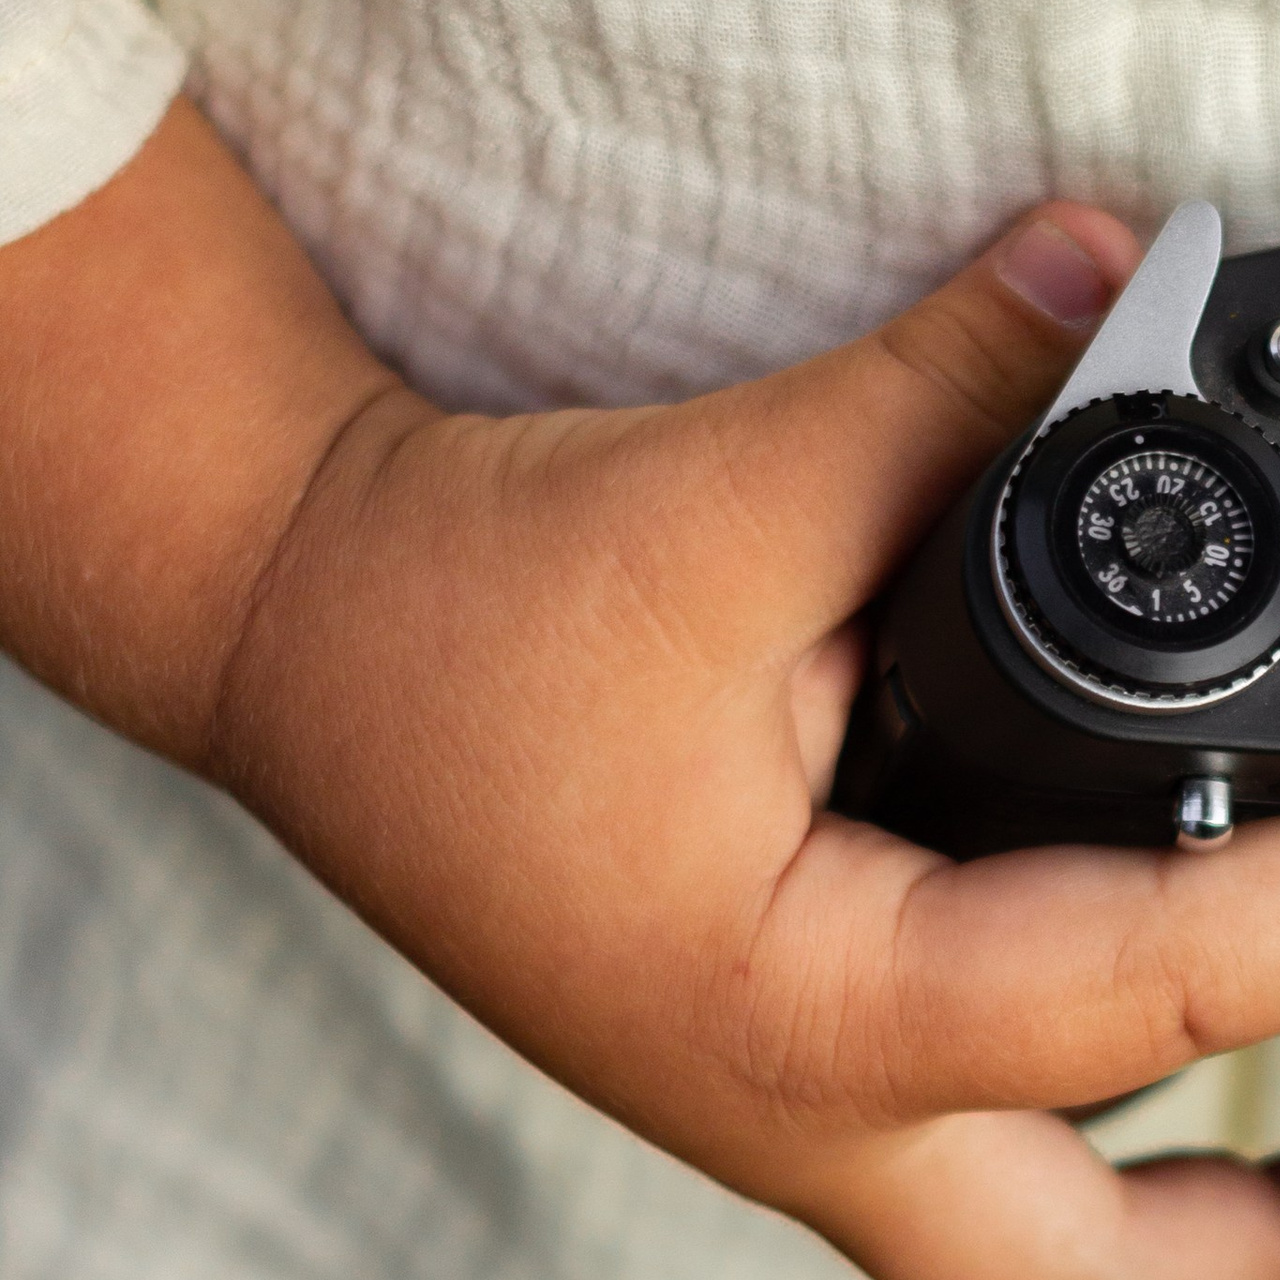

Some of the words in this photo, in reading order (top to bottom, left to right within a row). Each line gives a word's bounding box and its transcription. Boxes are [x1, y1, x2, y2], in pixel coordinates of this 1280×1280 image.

[1108, 477, 1140, 508] 25
[1156, 474, 1186, 496] 20
[1087, 512, 1115, 541] 30
[1199, 500, 1223, 527] 15
[1203, 544, 1231, 568] 10
[1097, 562, 1129, 594] 36
[1182, 578, 1202, 604] 5
[1151, 588, 1161, 612] 1
